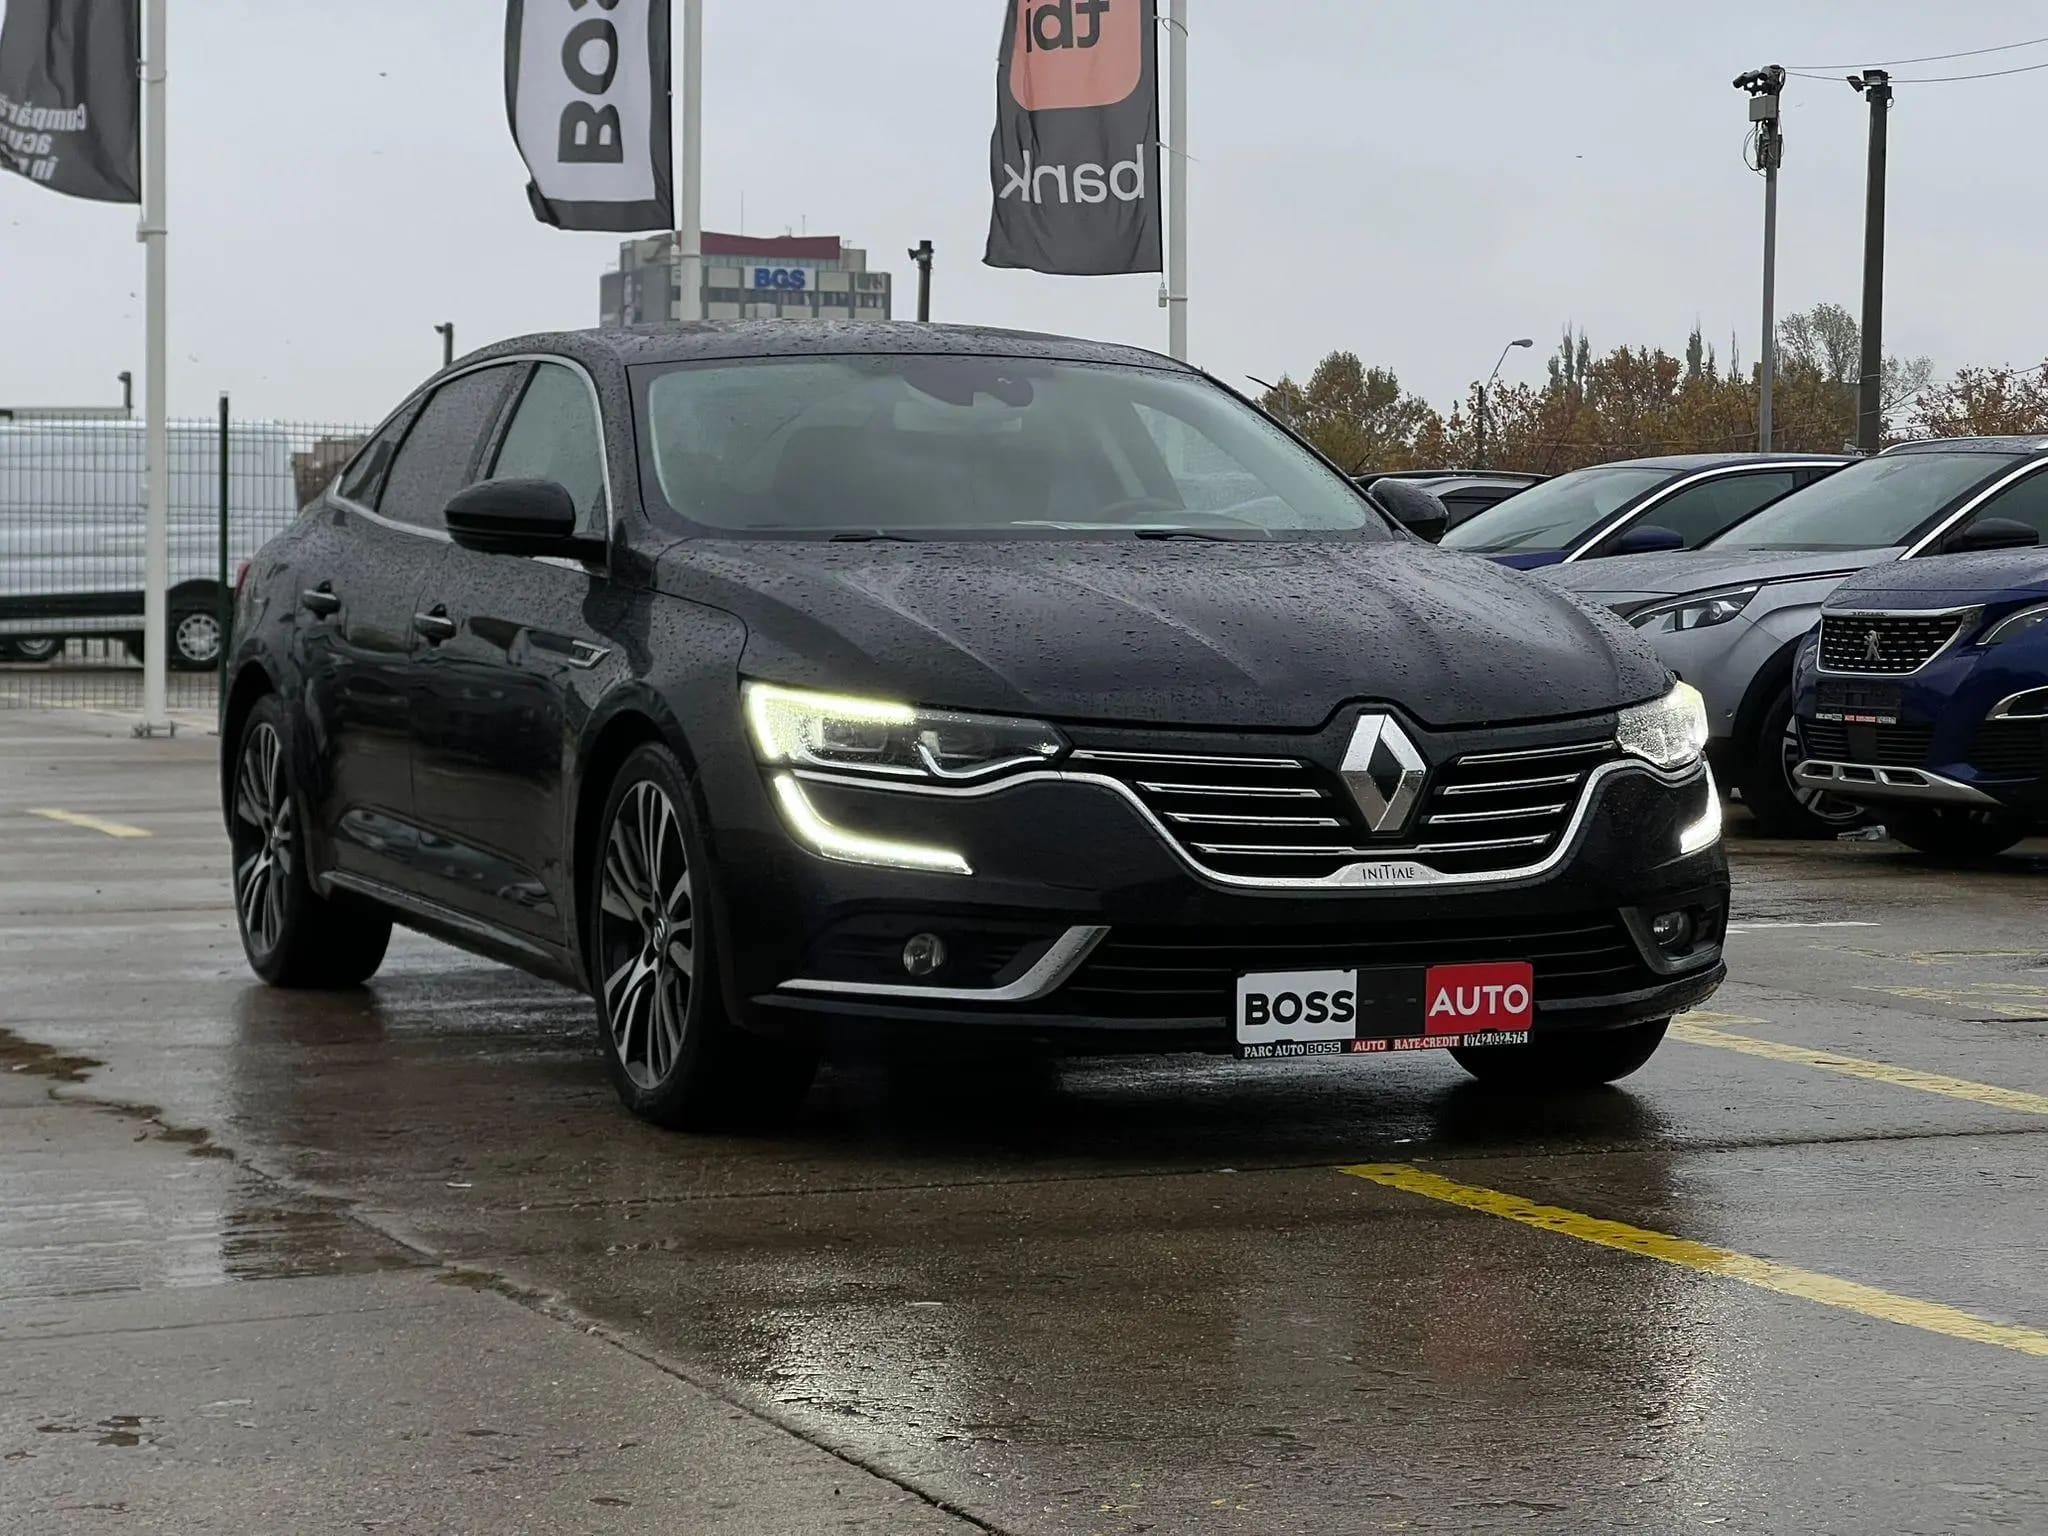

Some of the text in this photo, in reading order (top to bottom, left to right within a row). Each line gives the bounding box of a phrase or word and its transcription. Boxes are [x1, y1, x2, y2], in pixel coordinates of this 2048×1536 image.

[557, 0, 624, 163] BO
[754, 267, 806, 288] BGS
[1362, 864, 1415, 880] INITIALE
[1244, 983, 1529, 1026] BOSS AUTO
[1244, 1045, 1273, 1058] PARC
[1274, 1043, 1305, 1057] AUTO
[1307, 1042, 1341, 1055] BOSS
[1353, 1039, 1386, 1052] AUTO
[1394, 1035, 1460, 1050] RATE-CREDIT
